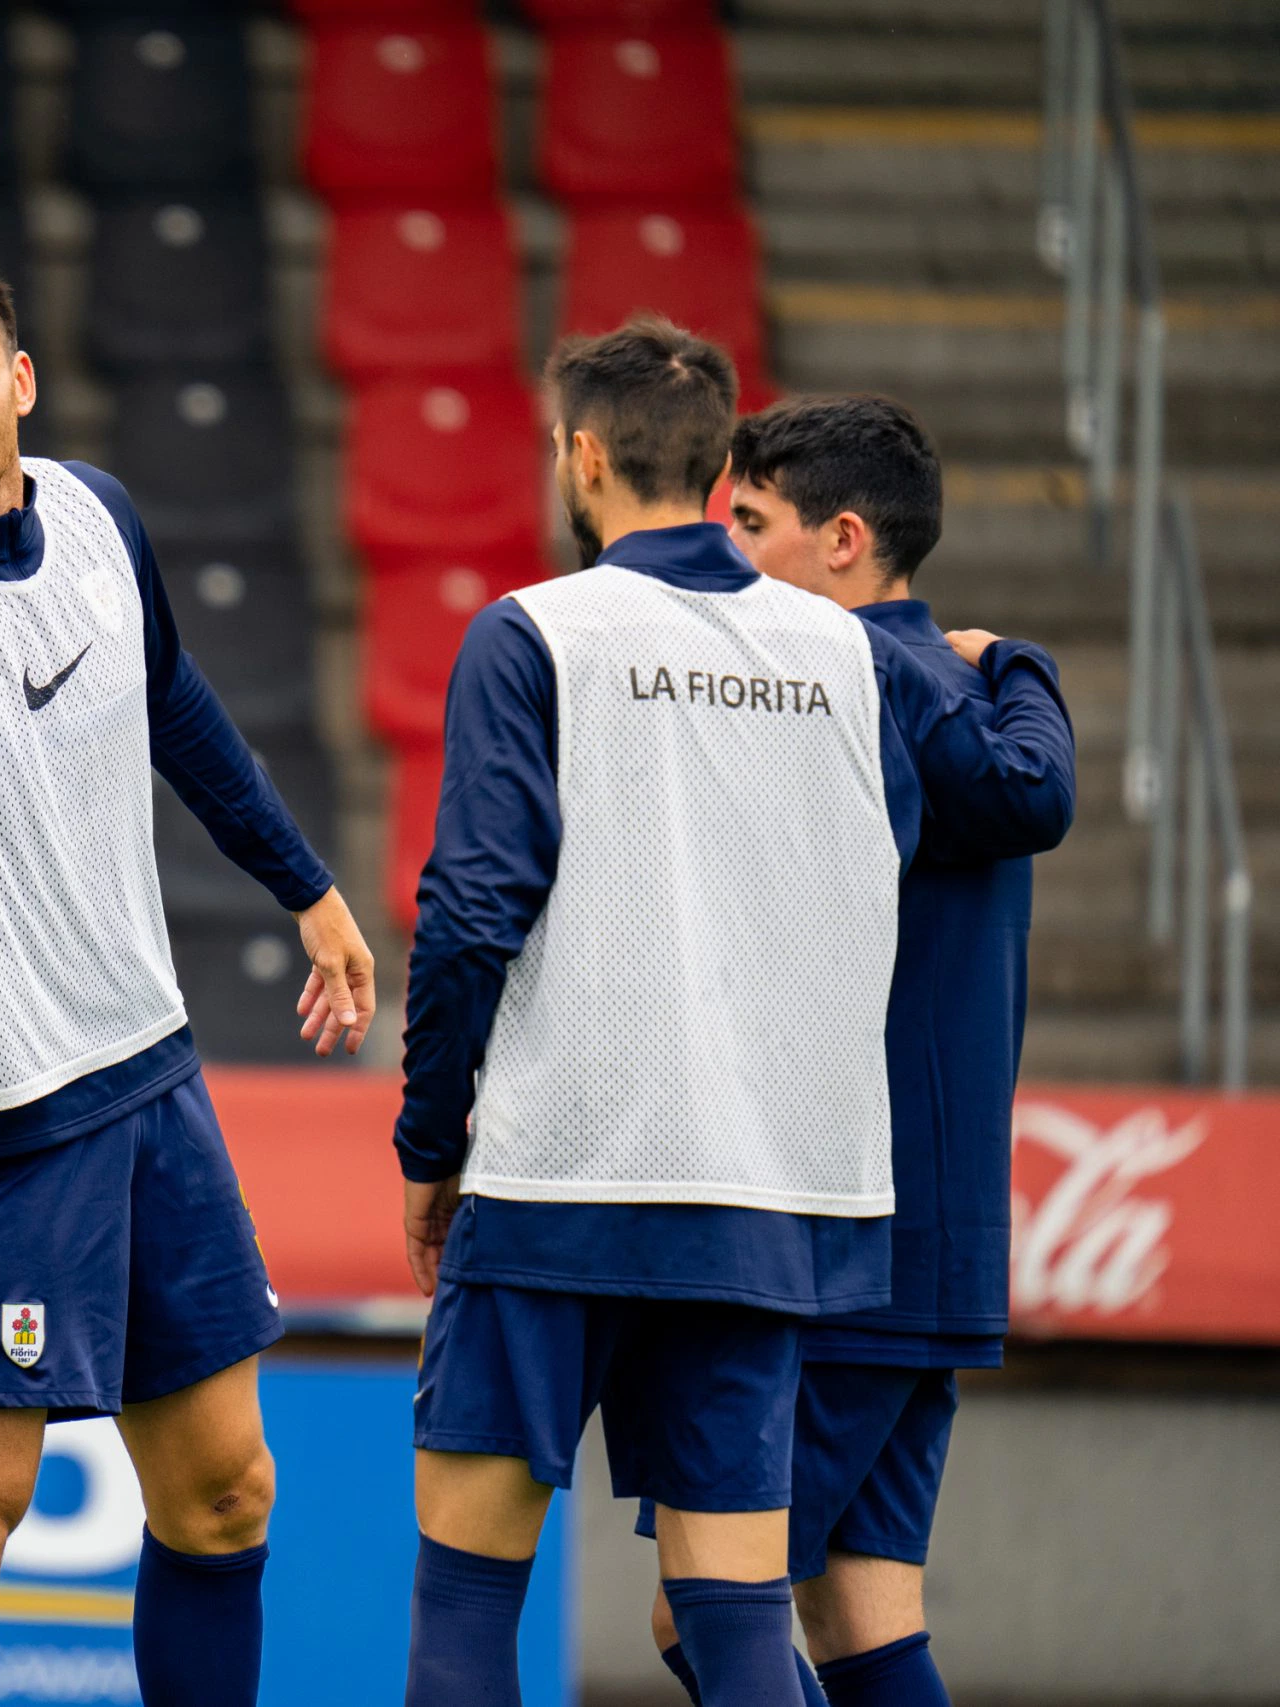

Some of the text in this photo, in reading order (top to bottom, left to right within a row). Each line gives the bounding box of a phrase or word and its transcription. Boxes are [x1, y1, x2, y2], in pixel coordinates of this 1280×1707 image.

[630, 665, 832, 716] LA FIORITA
[11, 1348, 38, 1357] Fiorita
